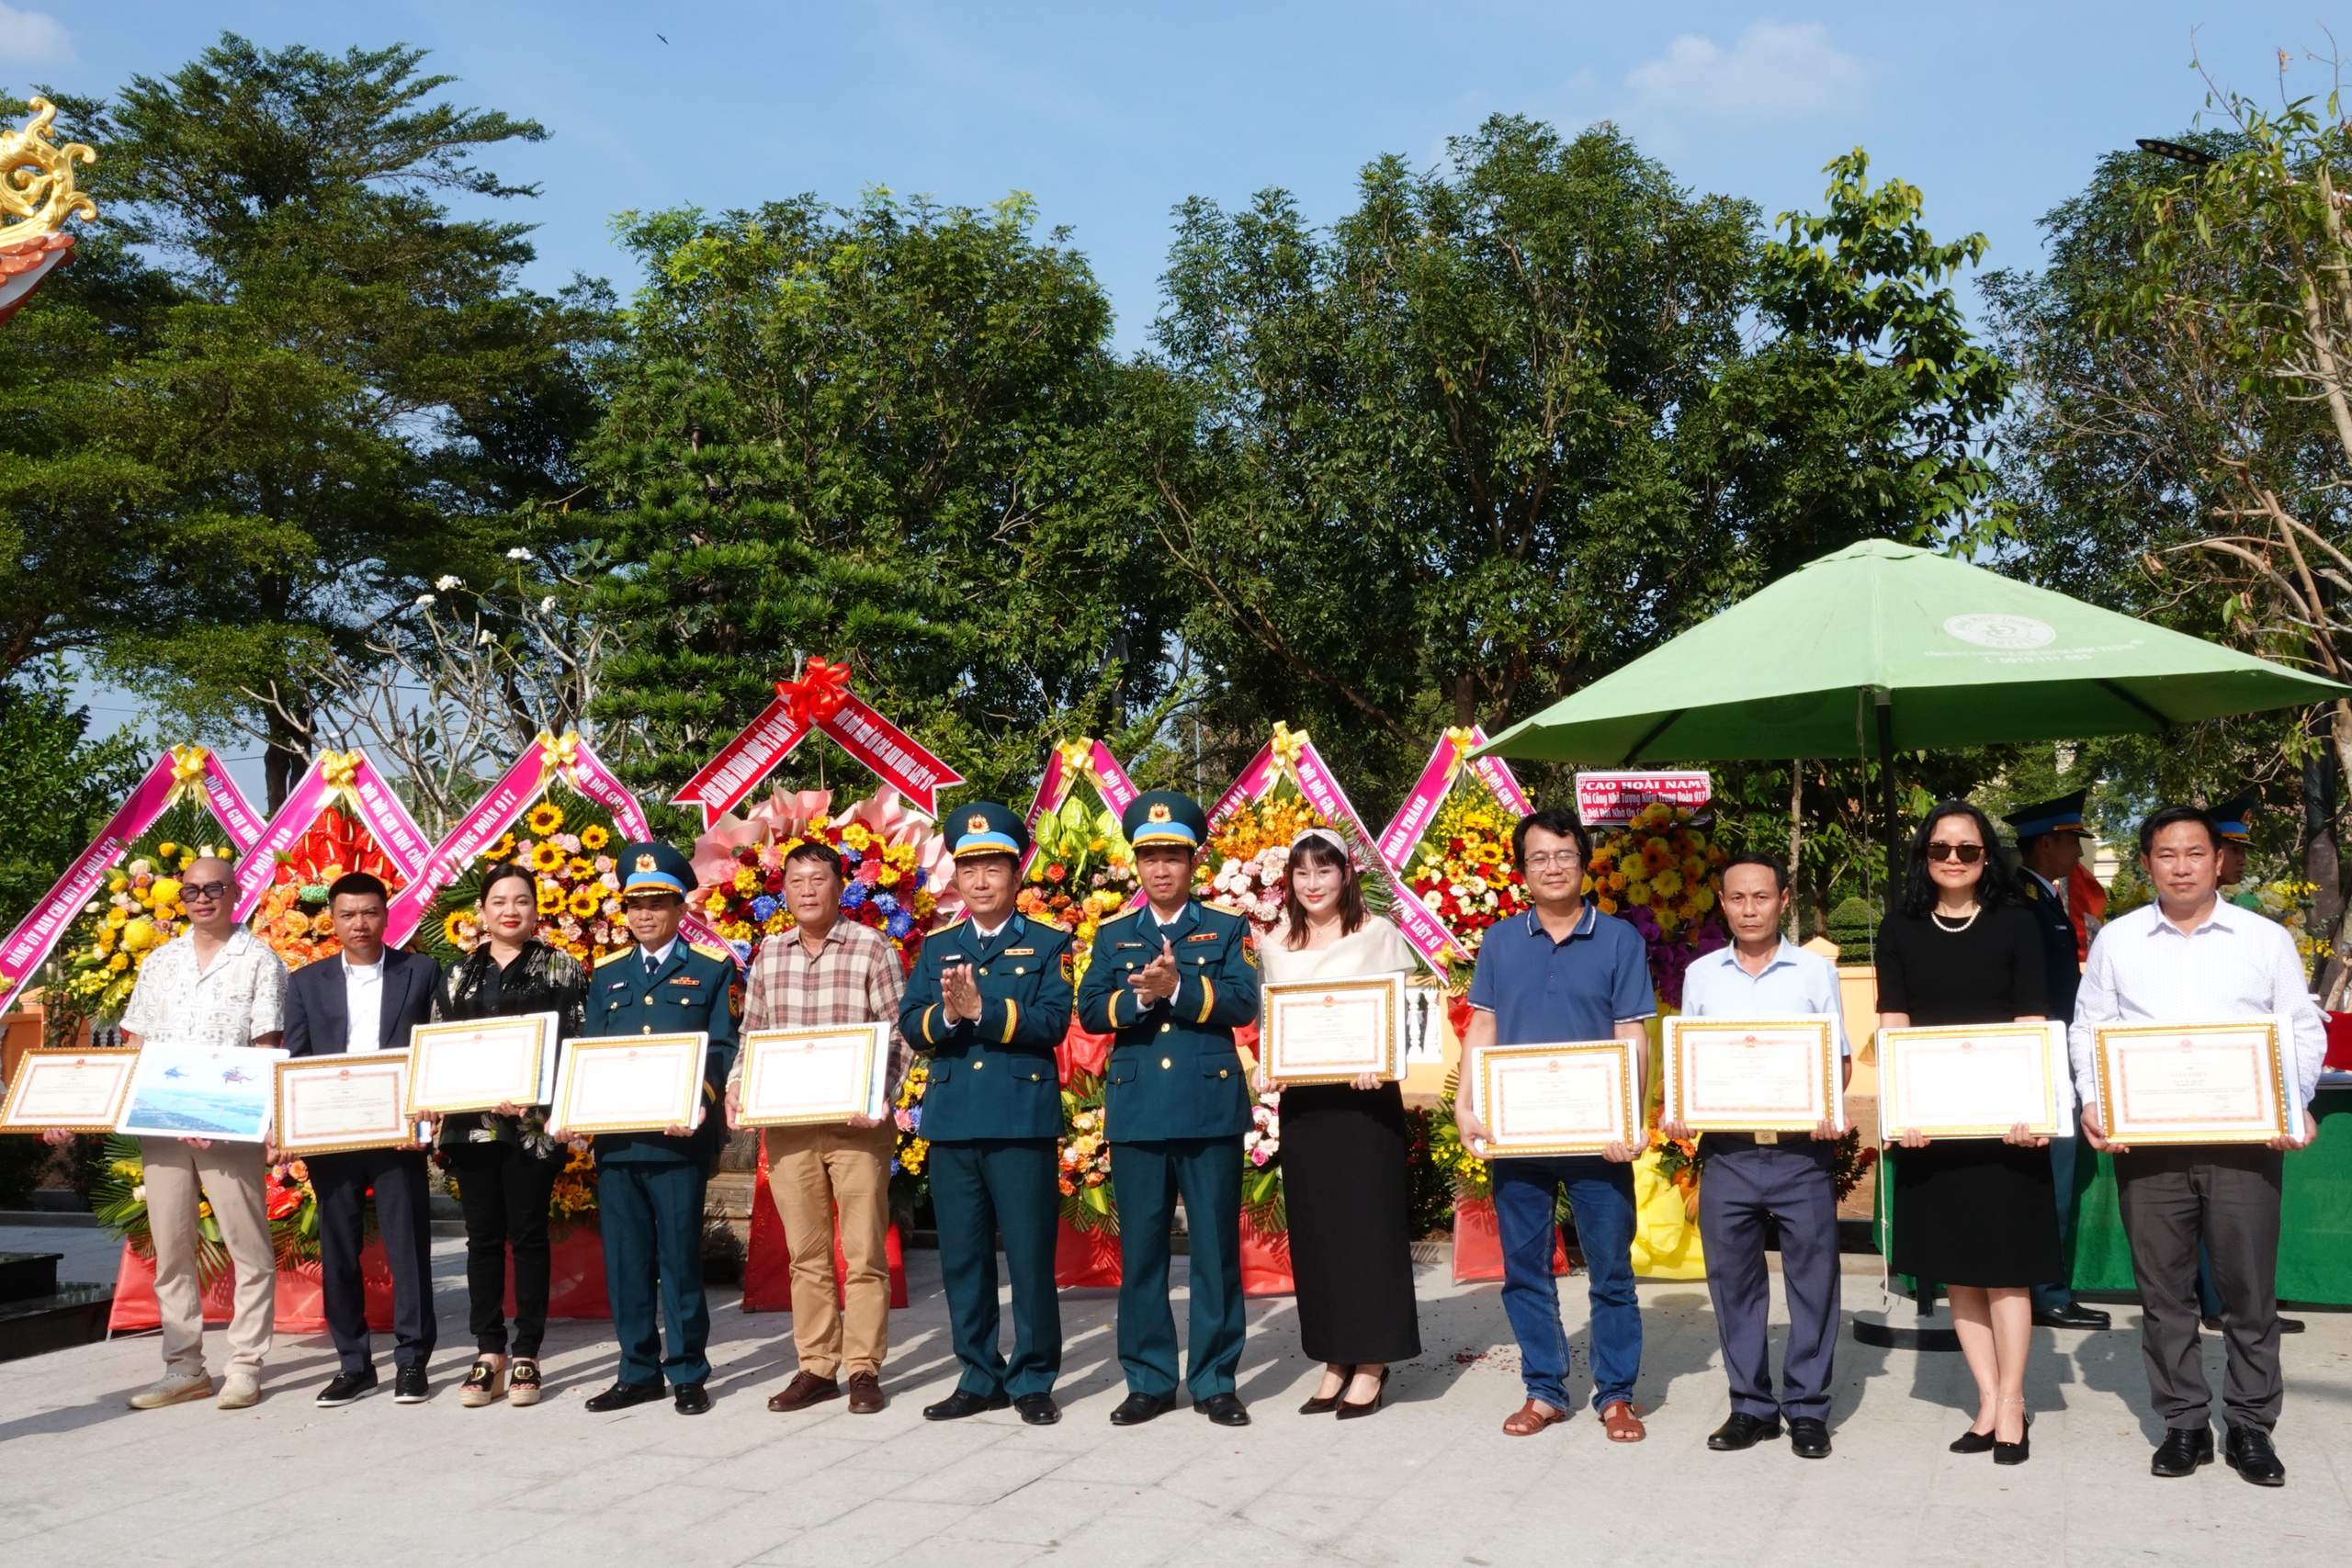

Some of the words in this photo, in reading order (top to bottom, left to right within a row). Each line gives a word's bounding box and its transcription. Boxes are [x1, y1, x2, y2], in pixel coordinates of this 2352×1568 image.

[588, 777, 609, 797] ĐỜI
[1102, 769, 1122, 789] ĐỜI
[1298, 761, 1317, 782] ĐỜI
[1308, 777, 1329, 799] ĐỜI
[1585, 782, 1617, 791] CAO
[1622, 779, 1661, 790] HOÀI
[1665, 781, 1702, 789] NAM
[358, 781, 379, 802] ĐỜI
[1228, 784, 1250, 807] 917
[1497, 787, 1516, 809] GHI
[1582, 793, 1592, 805] Thi
[1592, 792, 1608, 807] Công
[1694, 791, 1706, 803] 917
[214, 791, 235, 810] ĐỜI
[227, 808, 245, 830] GHI
[369, 796, 390, 818] ĐỜI
[379, 811, 401, 834] GHI
[1385, 817, 1408, 860] HOÀN
[1401, 794, 1430, 832] THÀNH
[271, 828, 293, 852] 918
[390, 828, 416, 852] NHỚ
[414, 886, 432, 906] PHI
[445, 829, 480, 863] TRUNG
[472, 806, 502, 836] ĐOÀN
[494, 788, 518, 813] 917
[405, 847, 426, 873] CÔN
[33, 914, 57, 939] BAN
[48, 897, 68, 919] CHỈ
[59, 884, 83, 908] HUY
[1409, 918, 1434, 943] LIỆT
